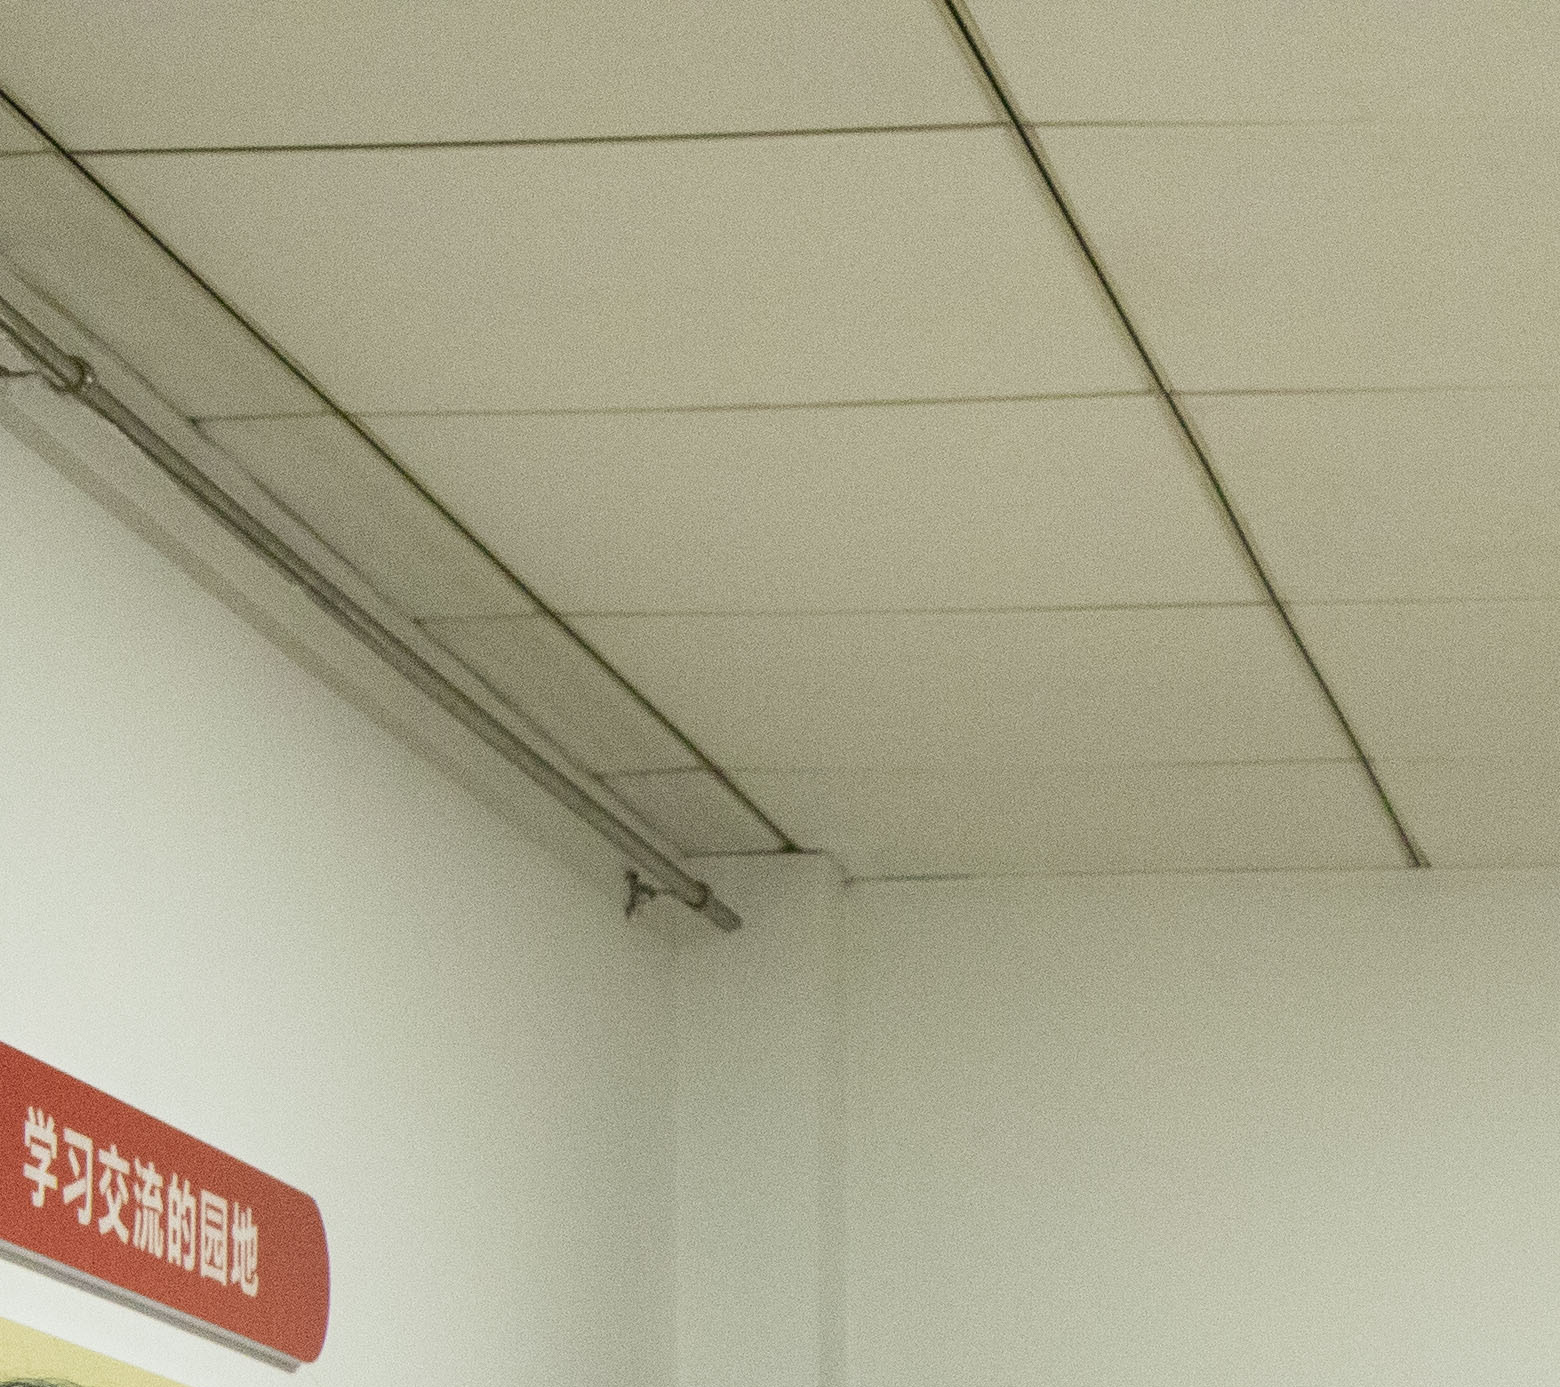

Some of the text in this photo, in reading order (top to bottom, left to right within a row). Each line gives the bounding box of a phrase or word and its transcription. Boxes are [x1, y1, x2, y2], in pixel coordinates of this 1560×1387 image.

[23, 1106, 260, 1298] 学习交流的园地
